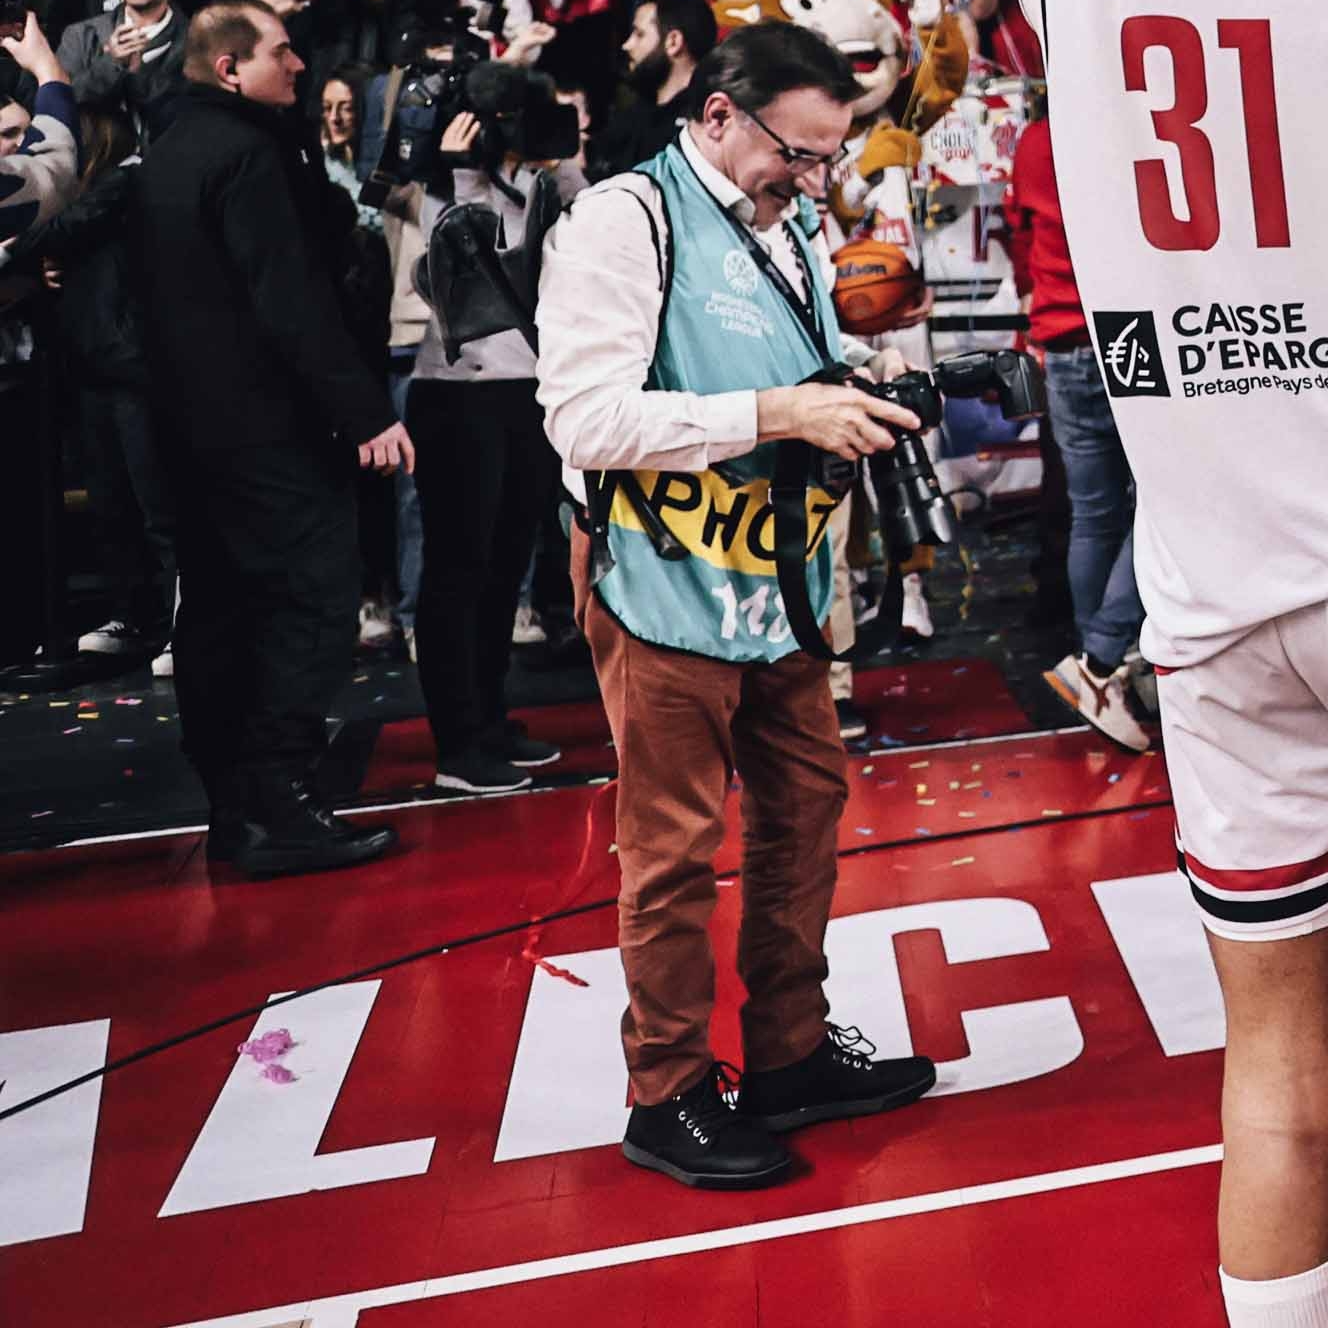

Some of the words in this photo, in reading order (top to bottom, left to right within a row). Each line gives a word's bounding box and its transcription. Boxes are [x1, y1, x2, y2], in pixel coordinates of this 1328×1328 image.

[1120, 15, 1292, 252] 31
[1172, 303, 1307, 337] CAISSE
[1183, 375, 1272, 398] Bretagne
[1273, 374, 1313, 395] Pays
